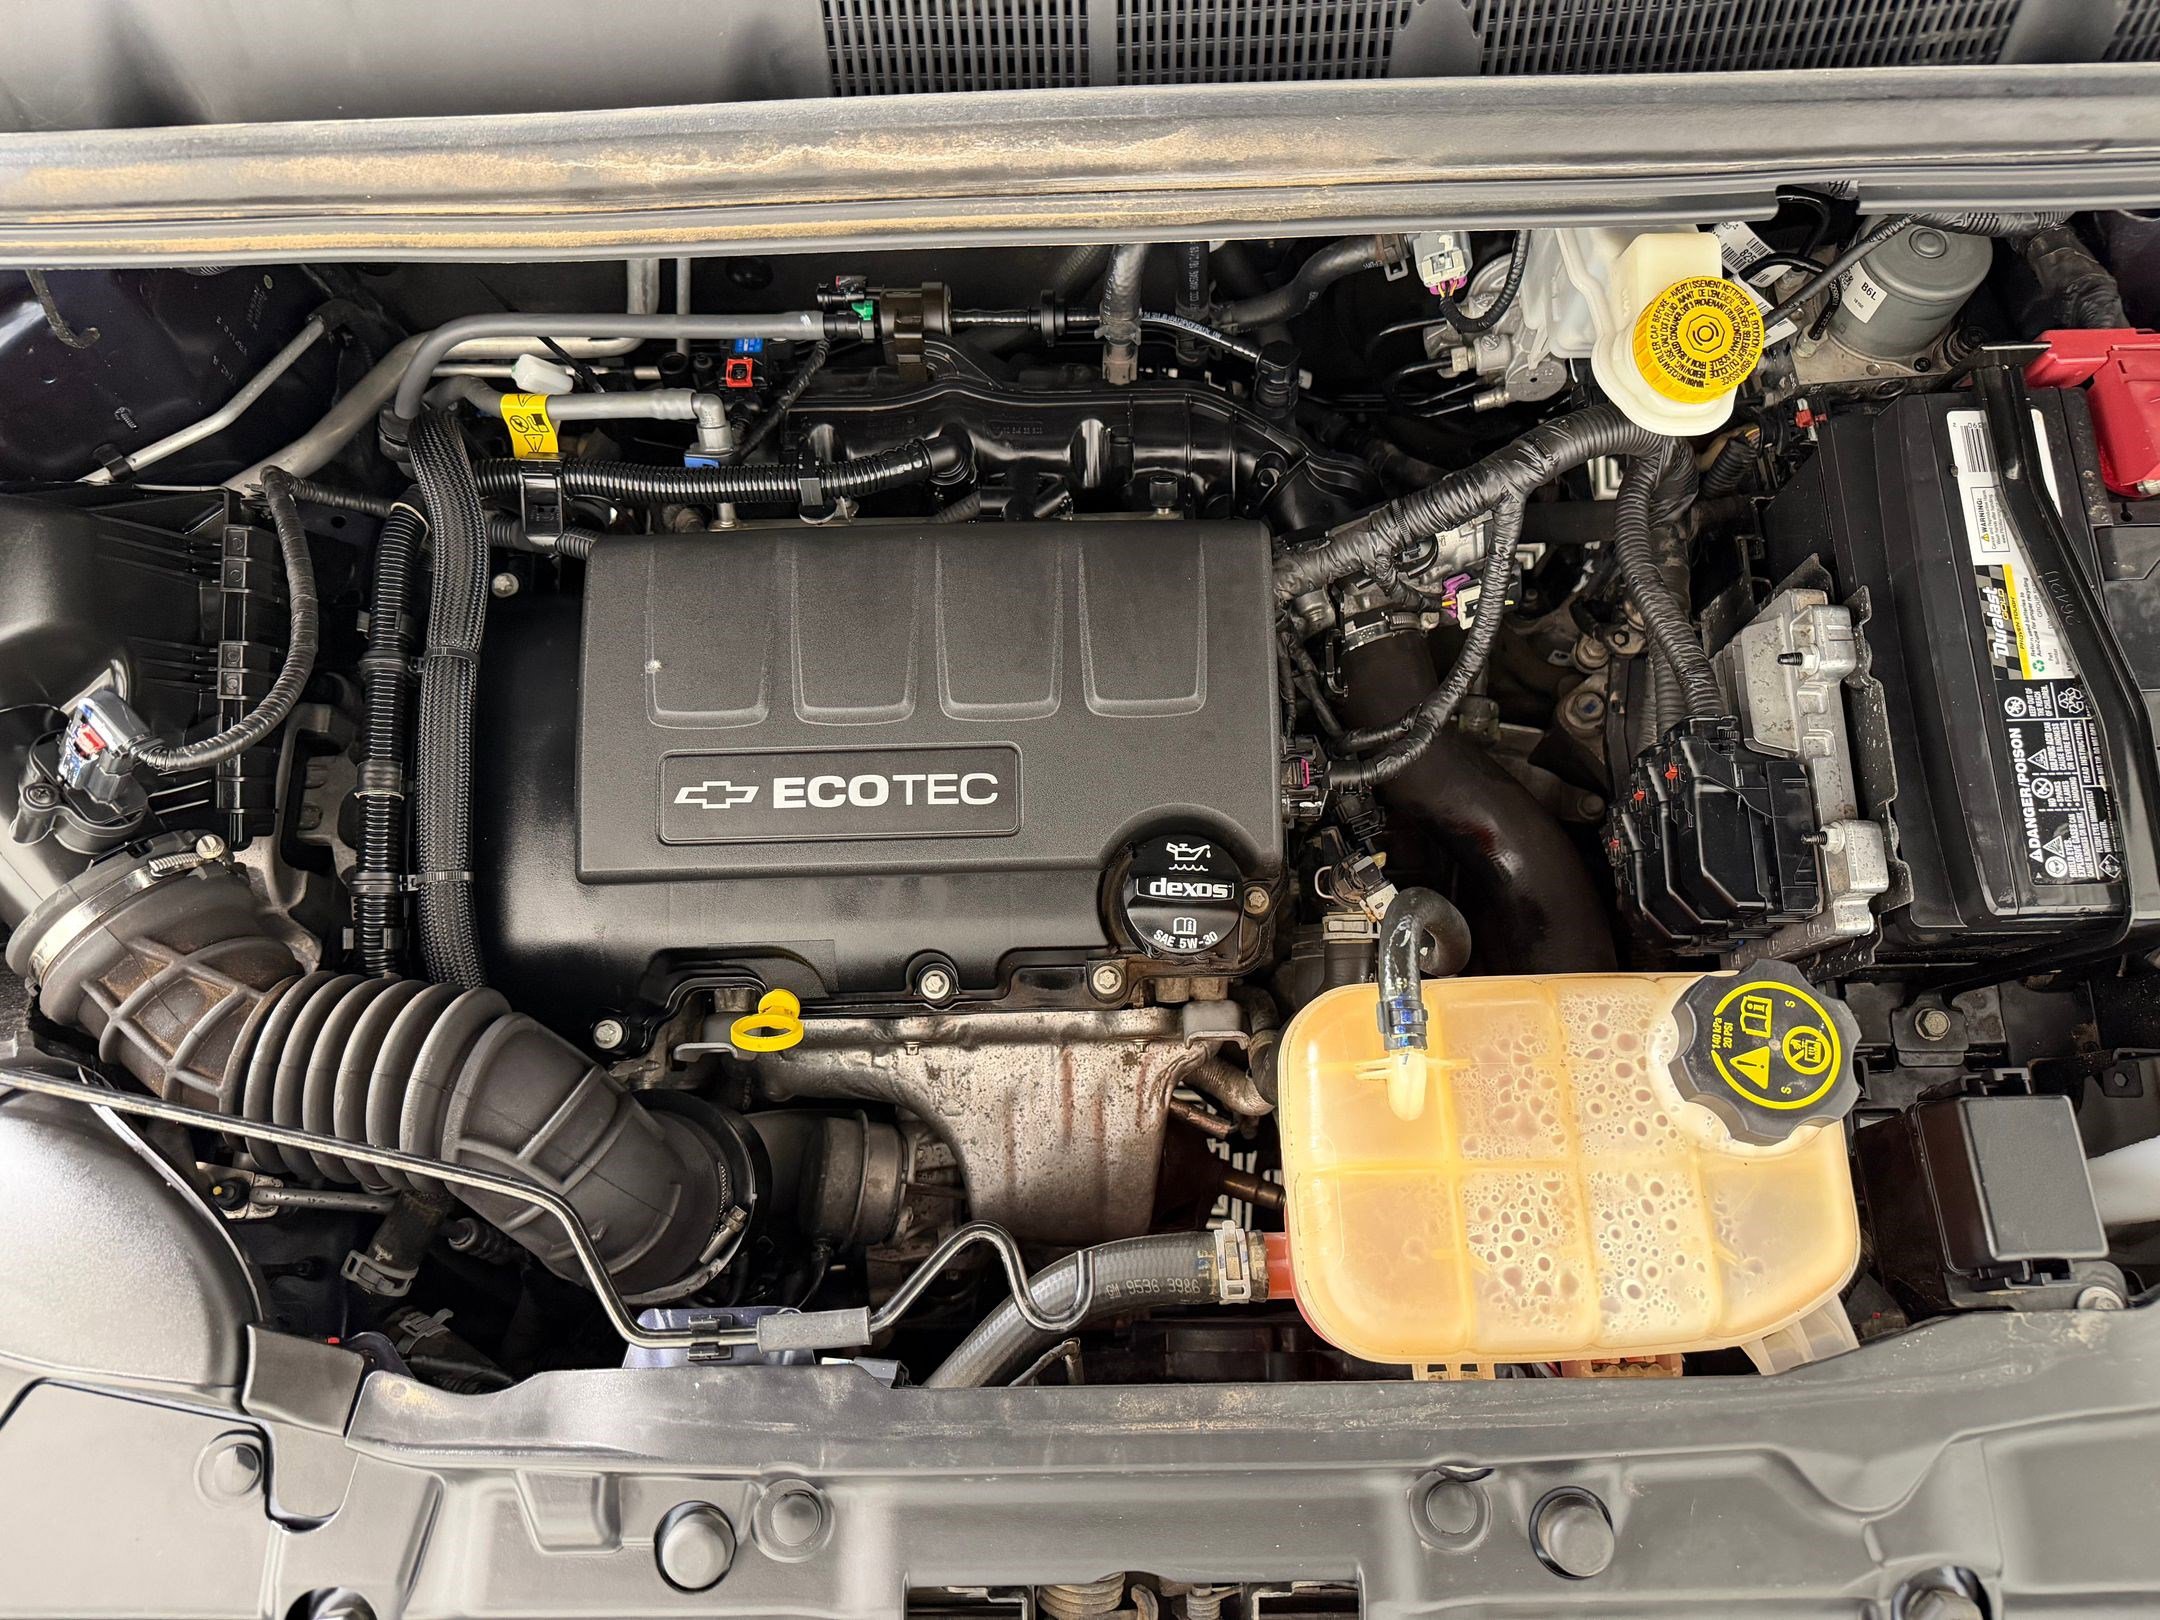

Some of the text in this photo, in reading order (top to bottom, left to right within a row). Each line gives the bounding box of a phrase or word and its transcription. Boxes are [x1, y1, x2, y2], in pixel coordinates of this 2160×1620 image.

[1739, 248, 1758, 263] 825
[1860, 281, 1878, 301] B6L
[1652, 298, 1669, 323] BEFORE
[1746, 308, 1756, 318] LE
[1650, 324, 1659, 339] CAP
[1660, 333, 1670, 348] ONLY
[1651, 341, 1666, 363] FILLER
[1663, 347, 1676, 362] USE
[1977, 498, 1987, 533] WARNING:
[2023, 577, 2032, 601] recycling
[1998, 588, 2009, 620] GOLD
[2021, 599, 2030, 623] batteries
[2028, 603, 2036, 620] proper
[1982, 587, 2009, 658] Duralast
[2011, 596, 2025, 649] PROVEN TOUGH
[2026, 695, 2034, 704] OUT
[2034, 692, 2043, 707] REACH
[2028, 705, 2036, 716] KEEP
[2045, 733, 2053, 745] ACID
[2052, 723, 2067, 770] CAUSE BLINDNESS
[2047, 746, 2059, 770] SULFURIC
[2063, 742, 2073, 761] SEVERE
[2067, 762, 2075, 770] OR
[2082, 767, 2092, 783] READ
[773, 772, 999, 809] ECOTEC
[2009, 728, 2041, 848] DANGER/POISON
[2053, 781, 2064, 802] SPARKS
[2062, 781, 2072, 802] FLAMES
[2069, 776, 2080, 802] SMOKING
[2048, 798, 2056, 807] NO
[2085, 790, 2103, 852] FLUSH EYES IMMEDIATELY
[2068, 814, 2086, 877] EXPLOSIVE GASES CAN
[2102, 839, 2112, 852] WITH
[1149, 877, 1228, 898] dexos
[1153, 929, 1218, 949] SAE 5W-30
[1711, 1017, 1723, 1049] 140 kPa
[1723, 1021, 1734, 1049] 20 PSI
